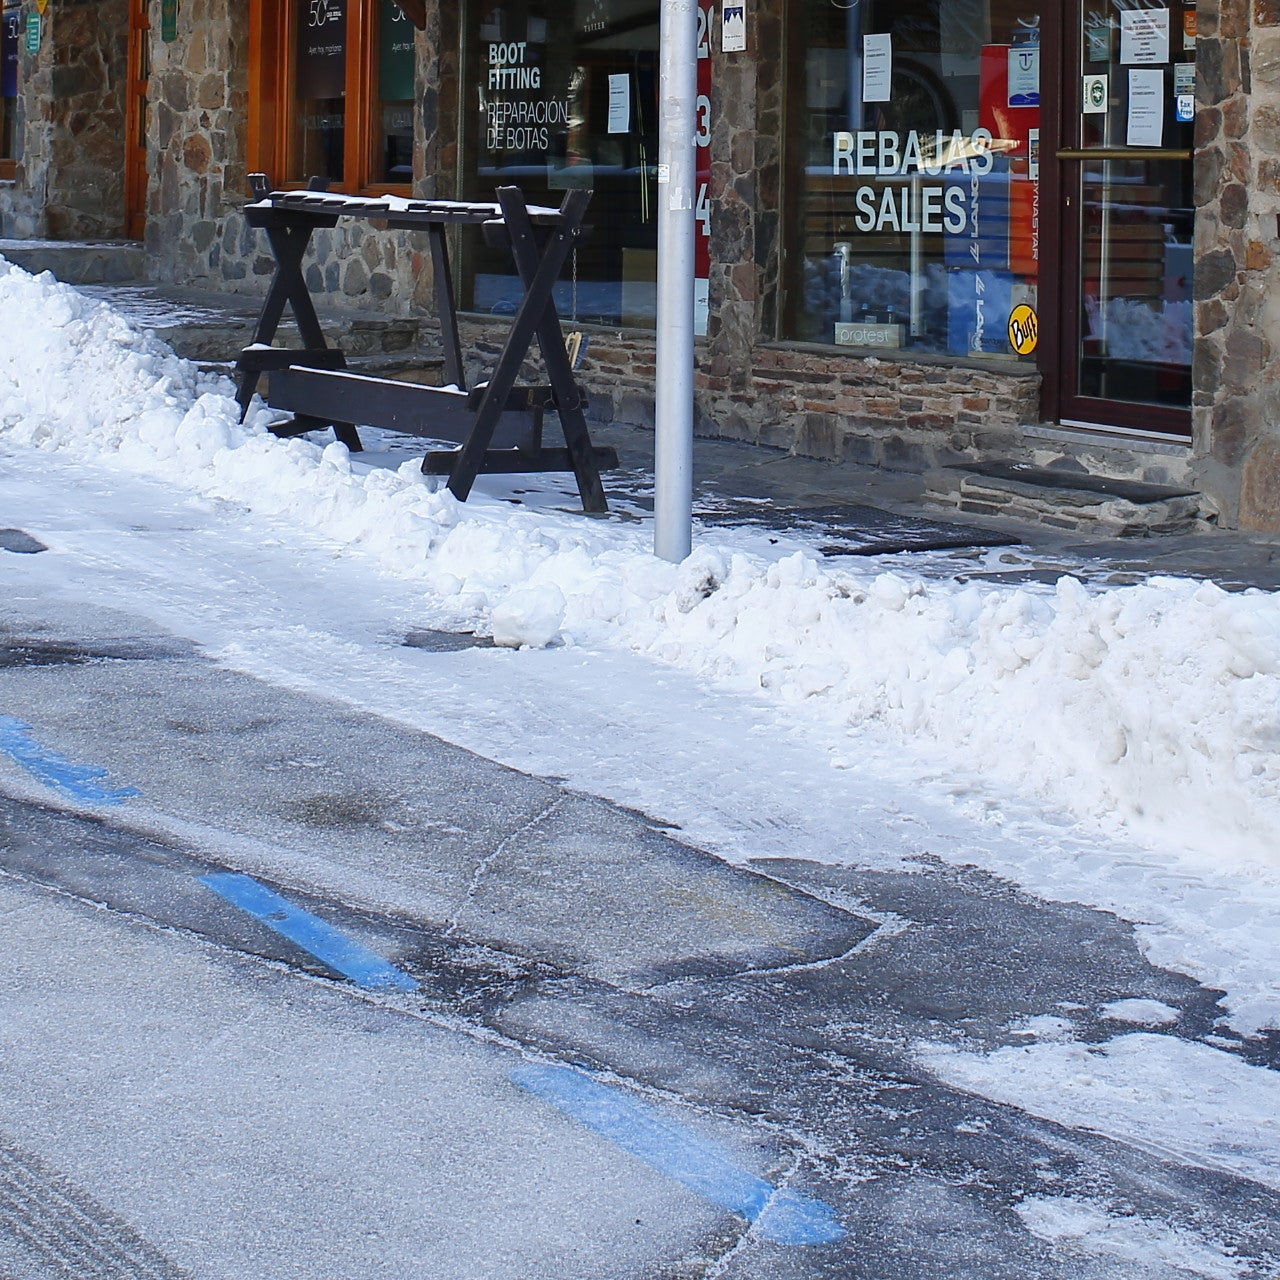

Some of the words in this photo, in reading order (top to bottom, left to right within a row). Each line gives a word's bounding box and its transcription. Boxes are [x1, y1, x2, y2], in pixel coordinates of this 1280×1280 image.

[488, 41, 527, 65] BOOT
[488, 66, 541, 90] FITTING
[487, 95, 568, 124] REPARACIÓN
[1179, 99, 1191, 109] tax
[1179, 107, 1193, 118] free
[486, 127, 504, 150] DE
[506, 127, 549, 150] BOTAS
[833, 127, 994, 176] REBAJAS
[854, 185, 967, 234] SALES
[839, 327, 890, 344] protest
